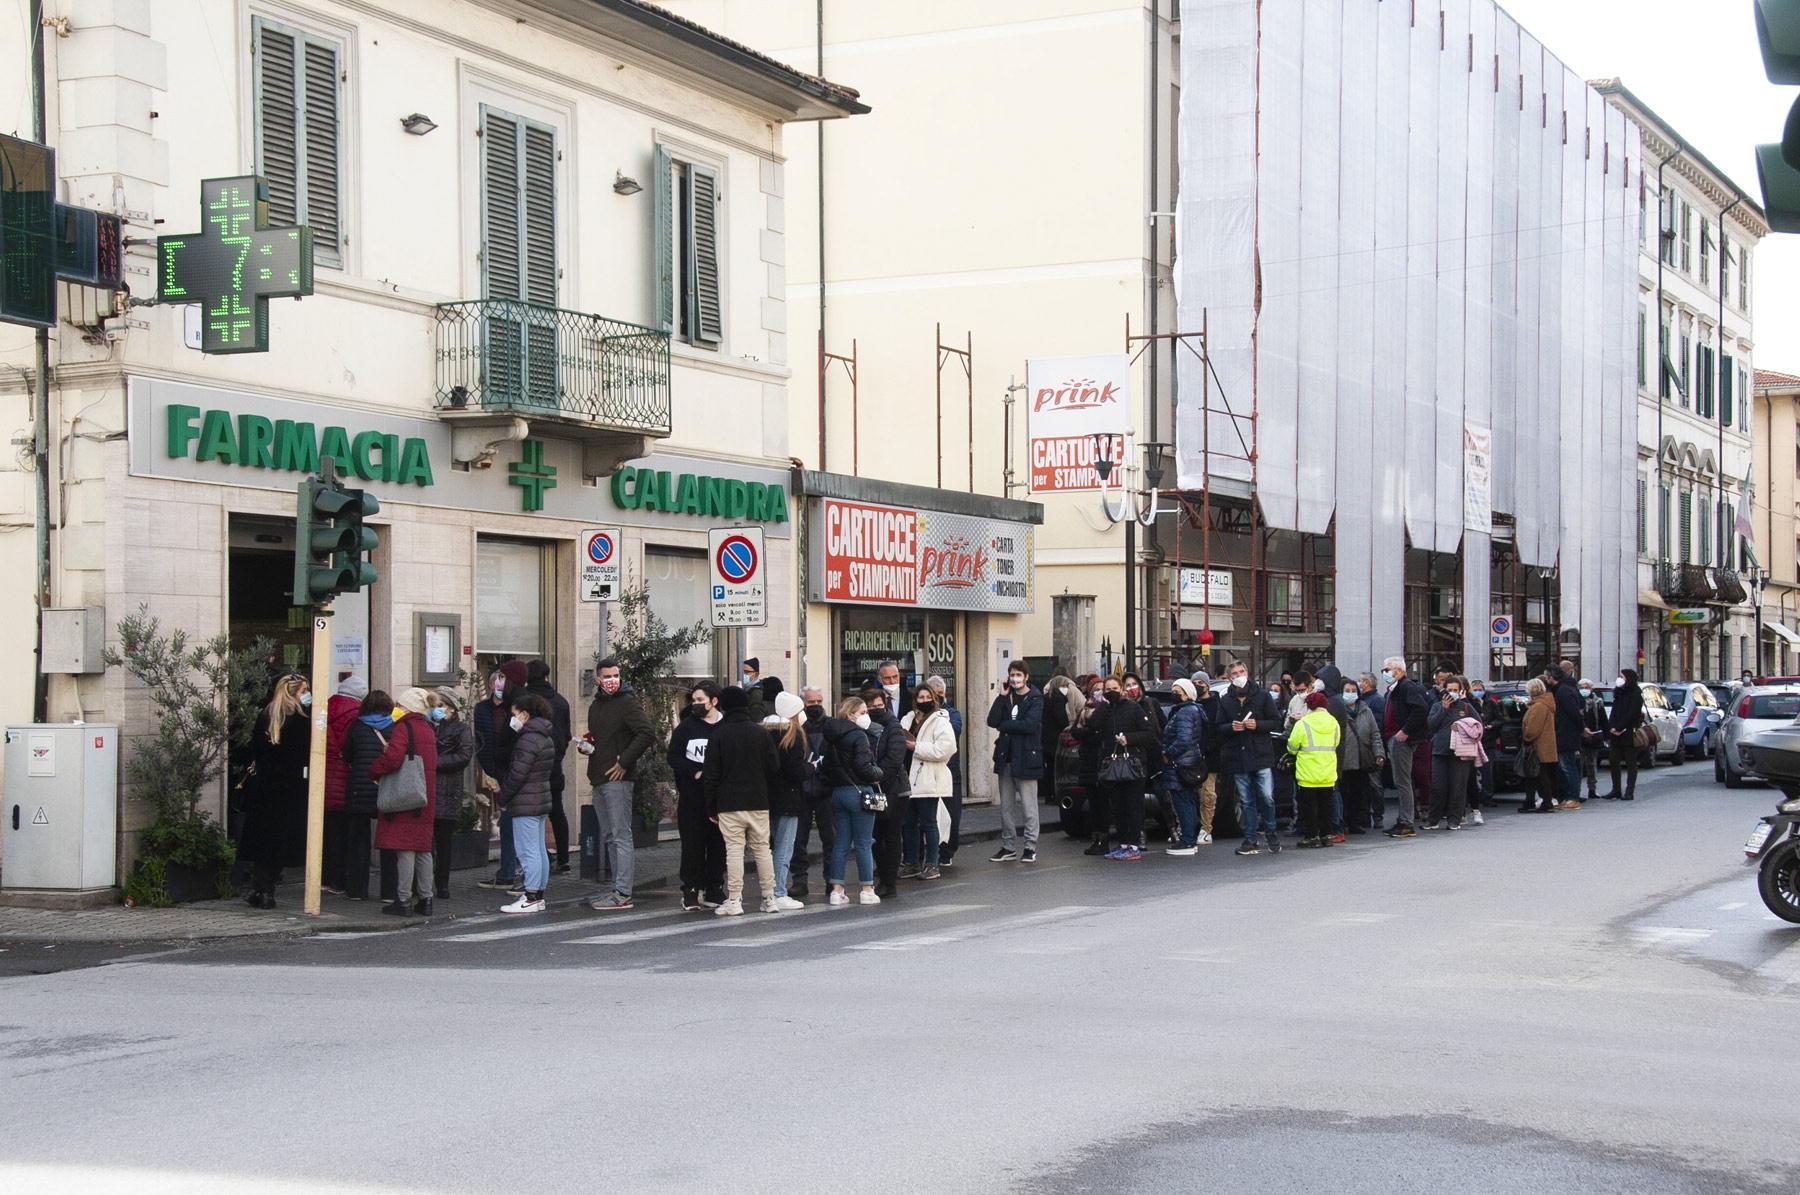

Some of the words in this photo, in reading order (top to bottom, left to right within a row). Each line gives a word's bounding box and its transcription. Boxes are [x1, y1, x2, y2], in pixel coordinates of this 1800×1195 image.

[1034, 380, 1120, 412] prink
[167, 404, 434, 487] FARMACIA
[1033, 436, 1122, 469] CARTUCCE
[1033, 474, 1047, 487] per
[1054, 467, 1121, 488] STAMPATI
[611, 466, 789, 523] CALANDRA
[827, 504, 915, 563] CARTUCCE
[996, 536, 1014, 553] CARTA
[920, 543, 988, 587] prink
[996, 558, 1014, 575] TONER
[1190, 573, 1228, 585] BUCFALO
[827, 570, 842, 592] per
[849, 561, 915, 600] STAMPANTI
[996, 580, 1027, 598] INCHIOSTRI
[845, 630, 889, 651] RICARICHE
[928, 633, 954, 662] SOS
